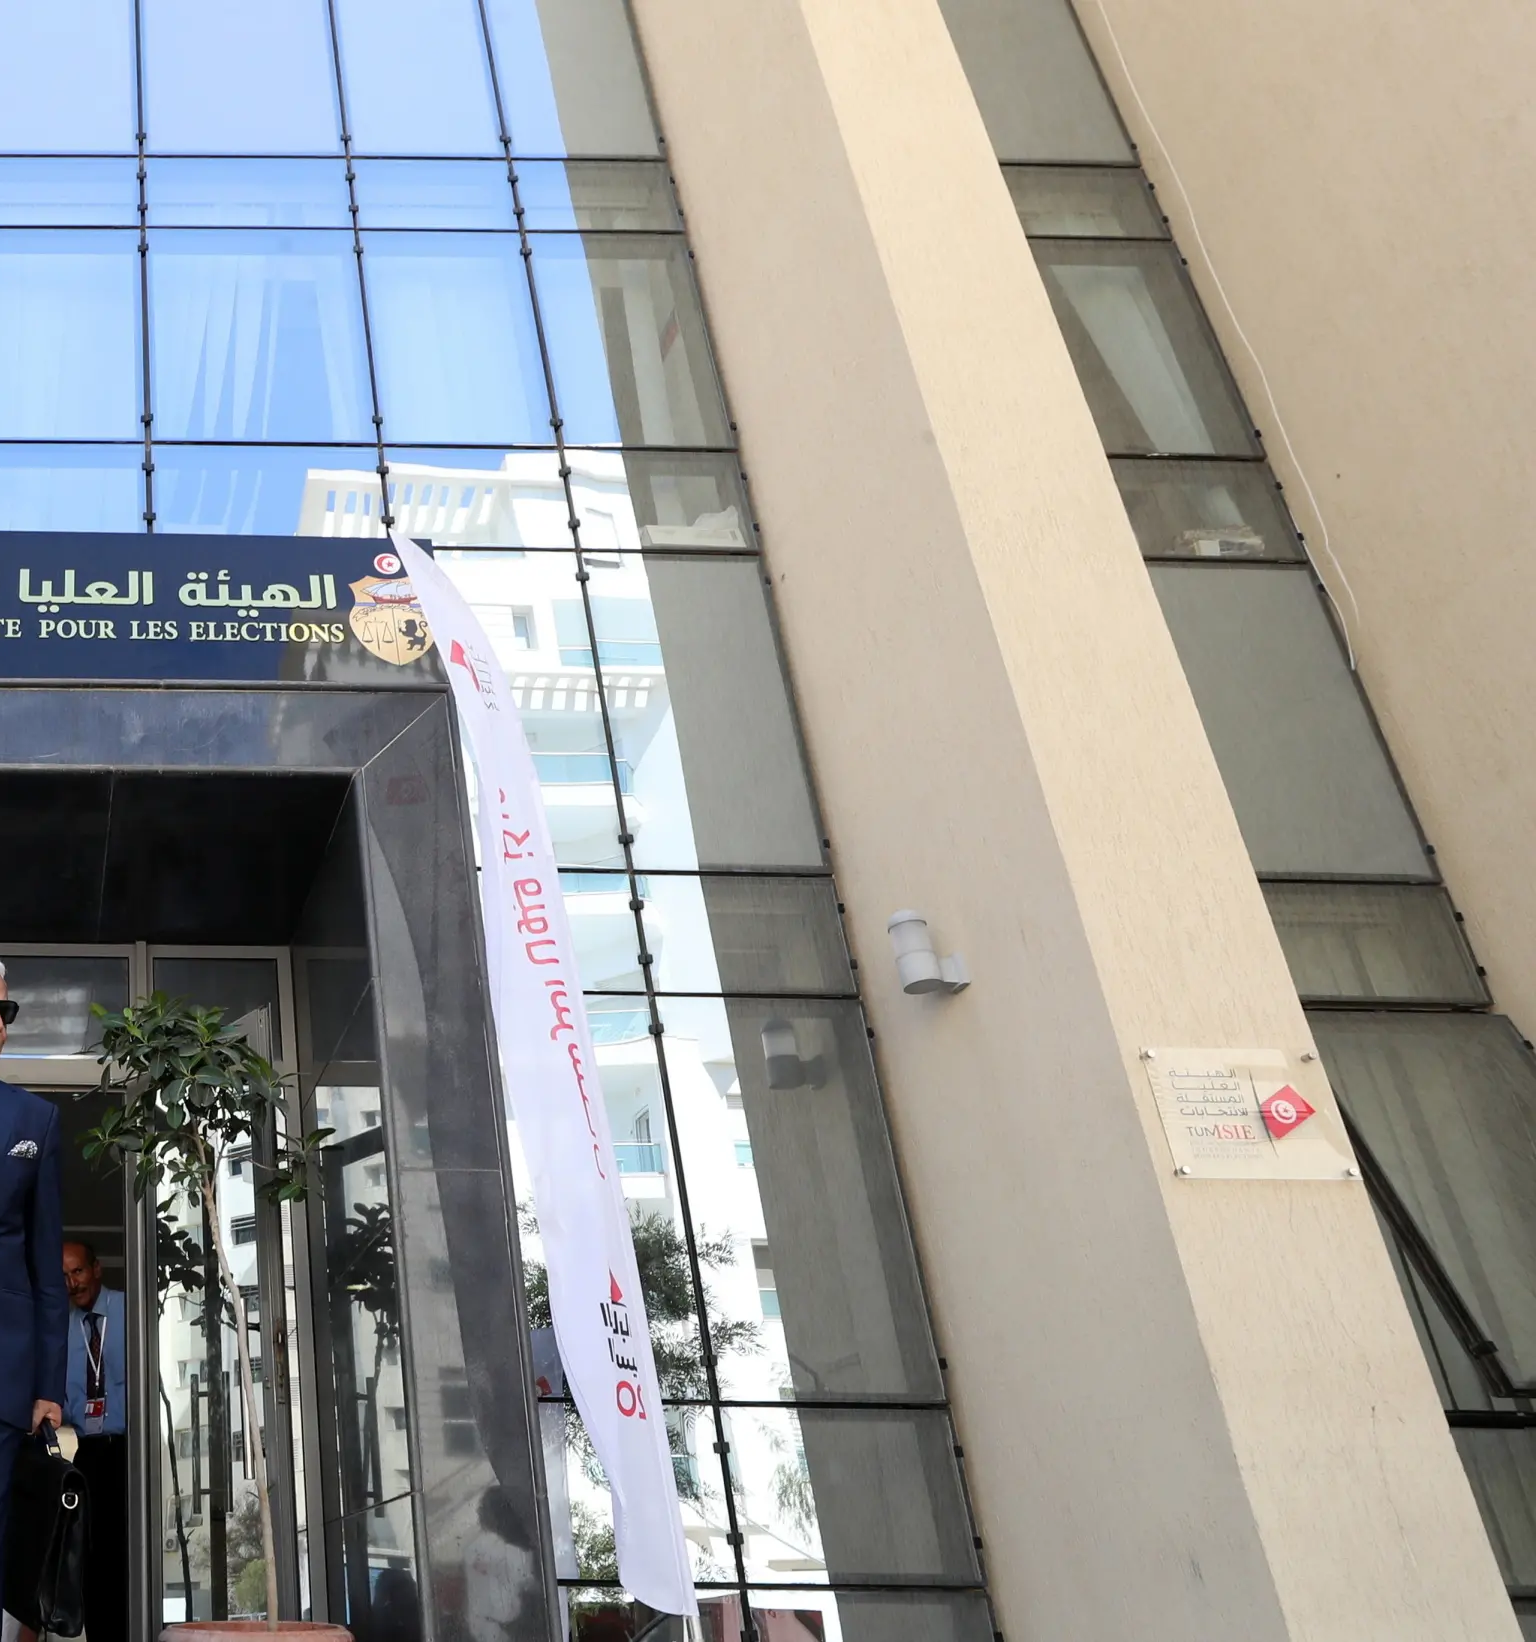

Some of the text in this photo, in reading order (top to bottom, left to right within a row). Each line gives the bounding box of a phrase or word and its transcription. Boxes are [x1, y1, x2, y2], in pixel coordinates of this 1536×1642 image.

[18, 567, 154, 613] العليا
[178, 569, 337, 618] الهيئة
[39, 618, 116, 640] POUR
[130, 619, 178, 641] LES
[189, 620, 345, 643] ELECTIONS
